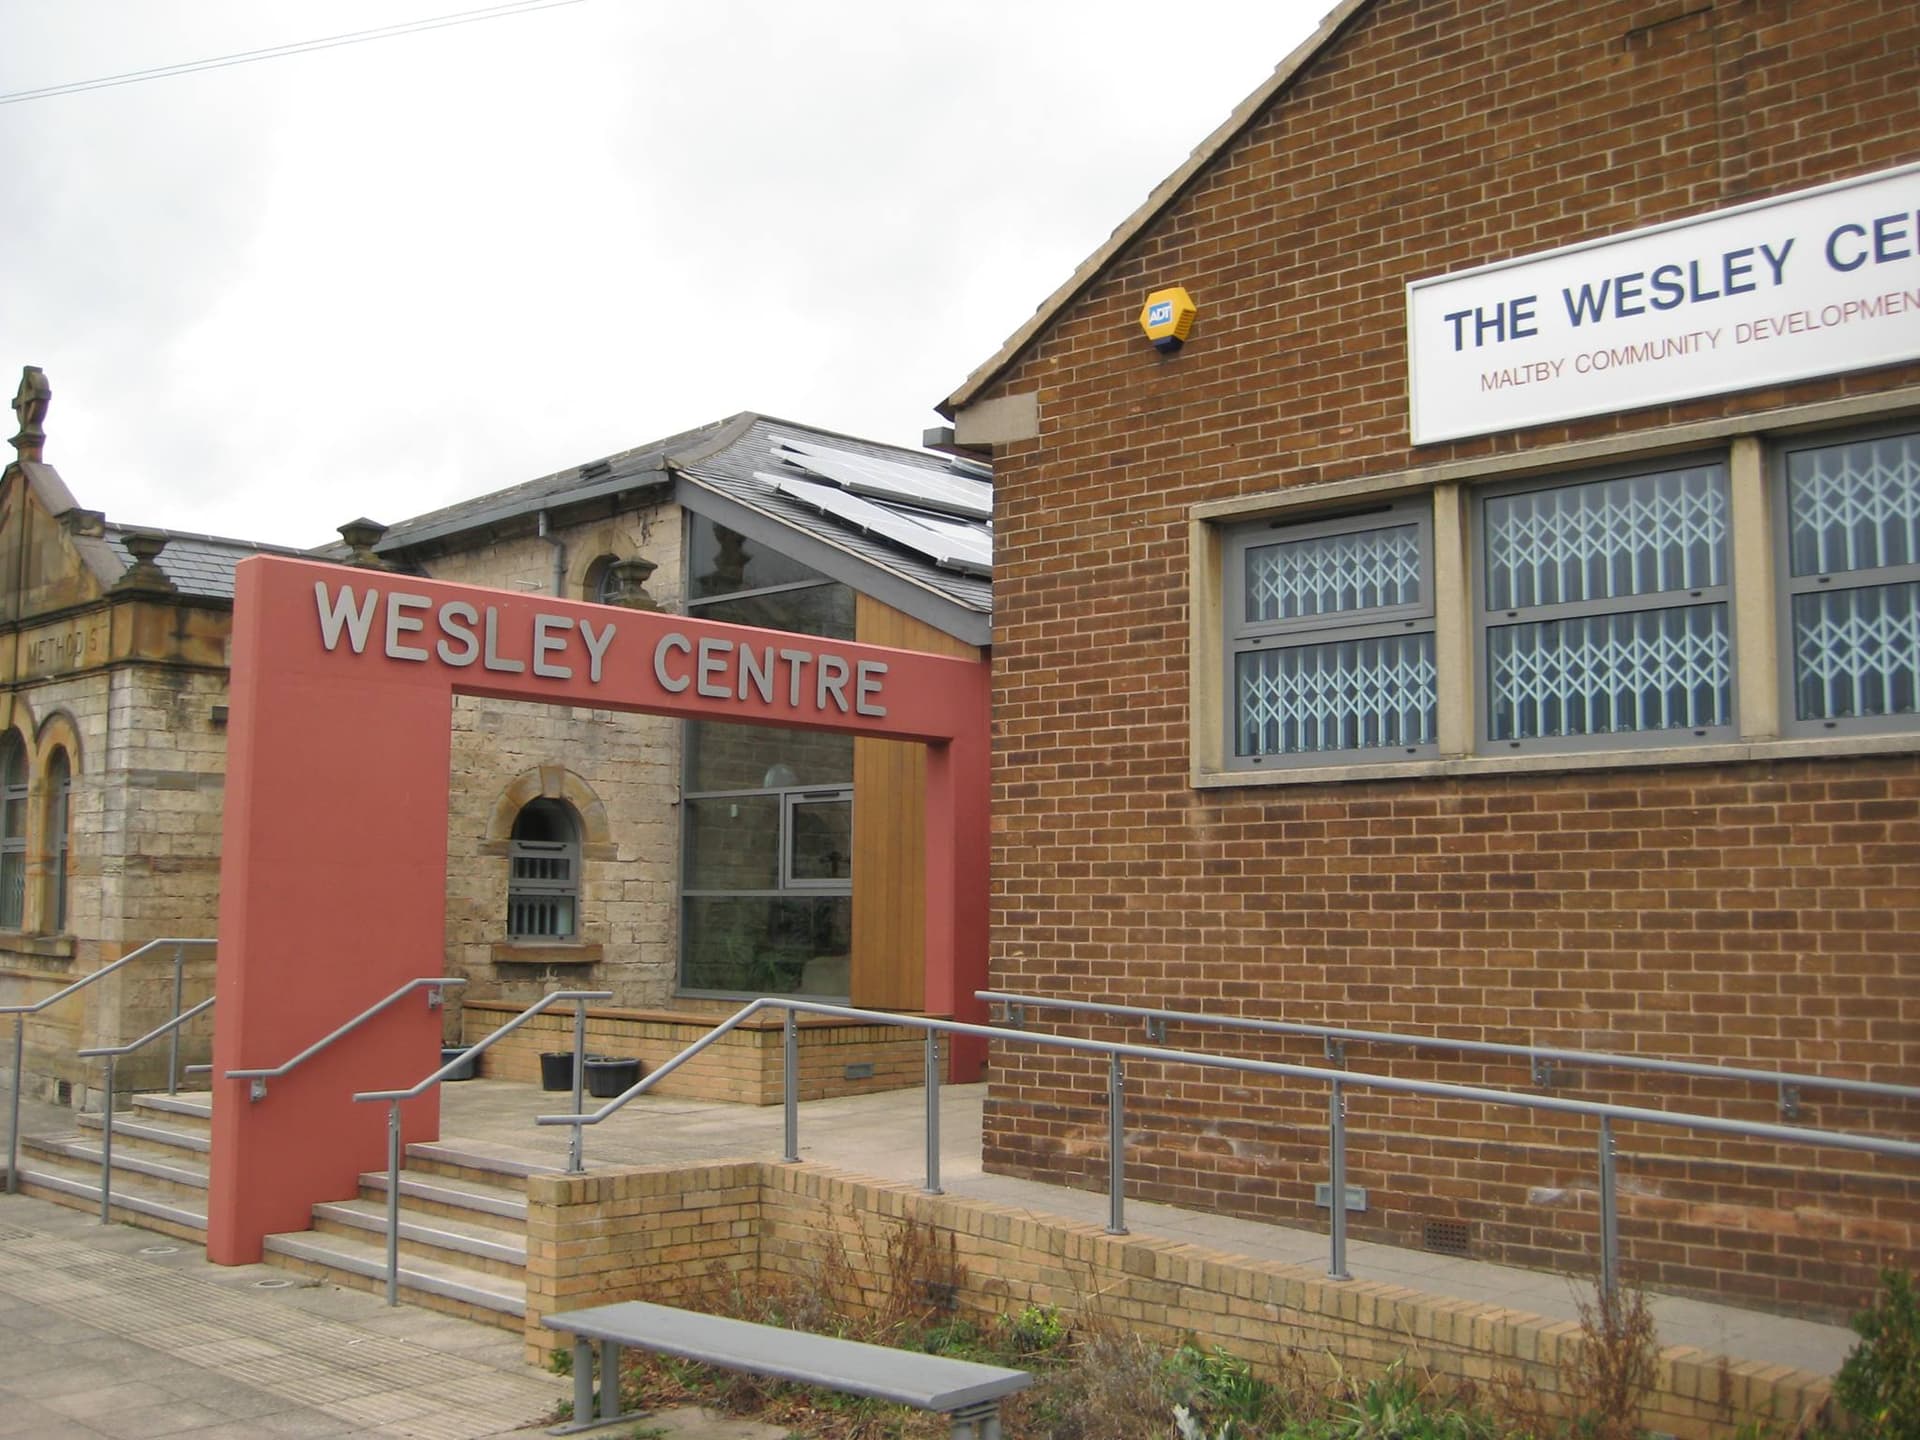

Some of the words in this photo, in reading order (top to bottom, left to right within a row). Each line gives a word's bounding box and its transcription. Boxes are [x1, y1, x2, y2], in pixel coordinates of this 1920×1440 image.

[1149, 305, 1171, 321] ADT
[1443, 295, 1538, 352] THE
[1562, 238, 1795, 328] WESLEY
[1825, 209, 1920, 273] CE
[1480, 359, 1565, 392] MALTBY
[1575, 328, 1721, 373] COMMUNITY
[1735, 288, 1920, 344] DEVELOPMEN
[315, 582, 615, 682] WESLEY
[654, 633, 888, 716] CENTRE
